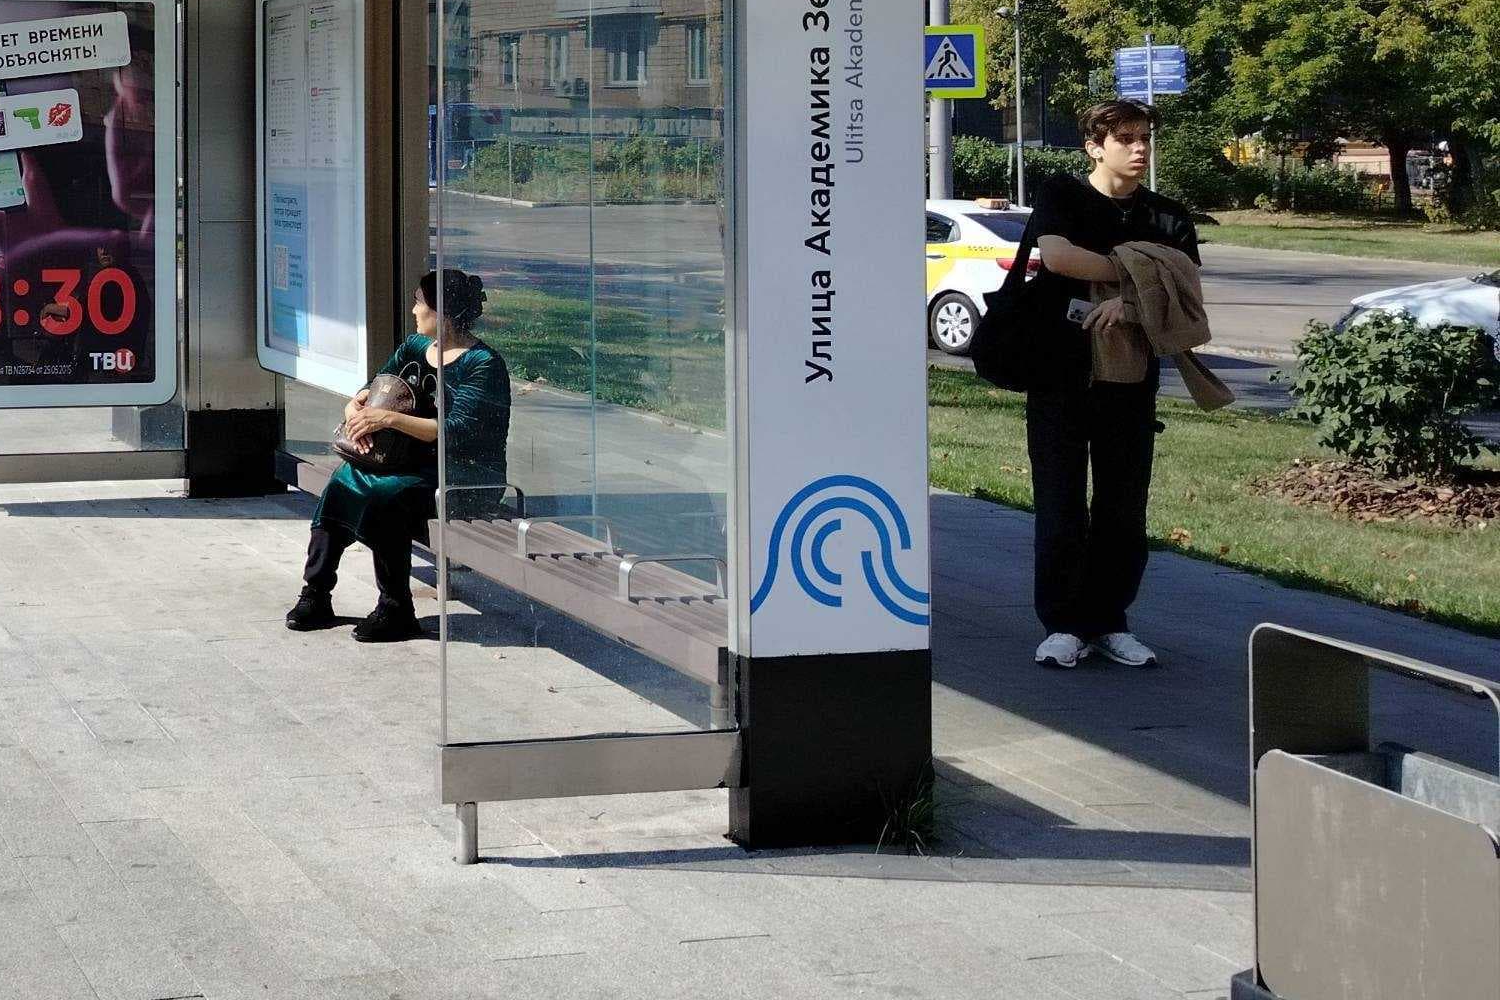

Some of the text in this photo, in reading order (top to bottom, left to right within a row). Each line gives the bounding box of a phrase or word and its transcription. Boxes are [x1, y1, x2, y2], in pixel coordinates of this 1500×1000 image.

[28, 24, 103, 44] ВРЕМЕНИ
[804, 47, 836, 256] Академика
[844, 99, 864, 163] Ulitsa
[804, 270, 836, 384] Улица
[89, 350, 133, 372] ТВЦ
